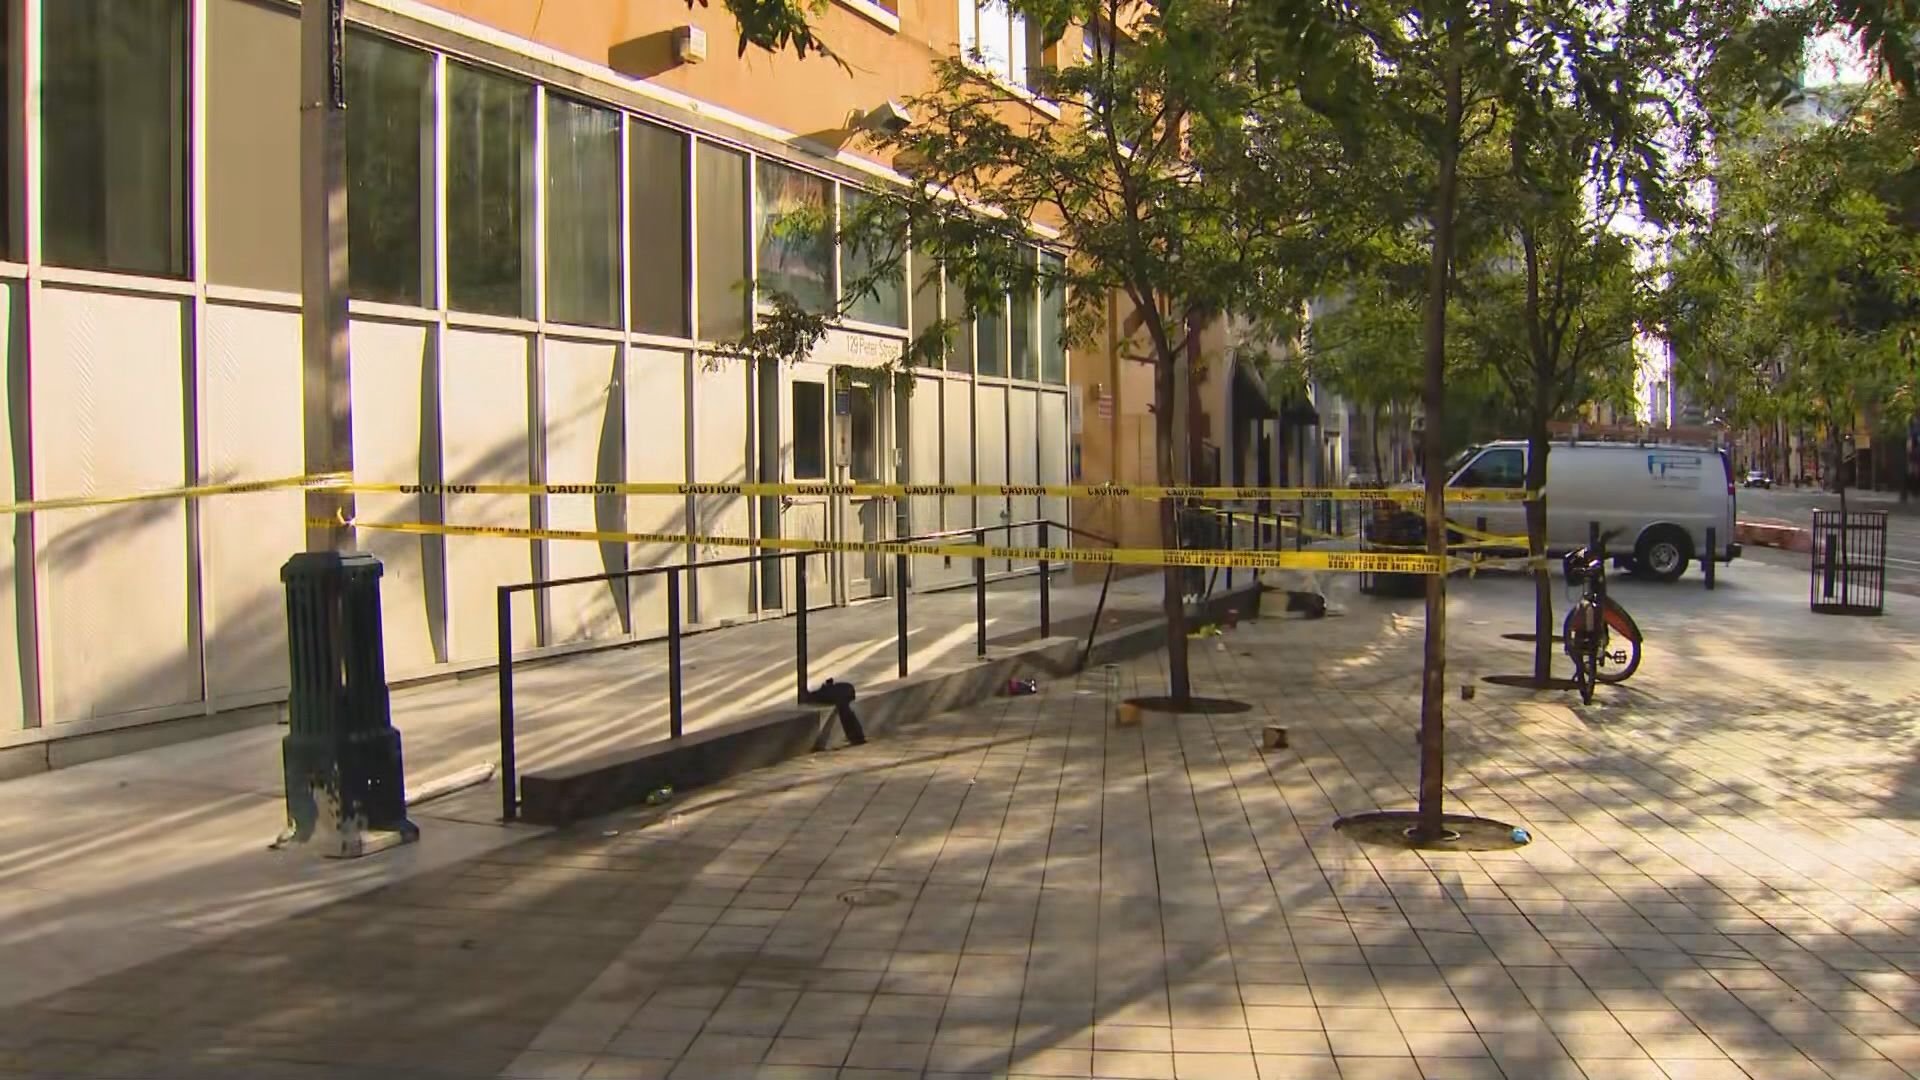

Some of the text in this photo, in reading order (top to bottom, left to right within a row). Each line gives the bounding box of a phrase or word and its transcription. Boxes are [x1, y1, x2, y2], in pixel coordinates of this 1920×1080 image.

[847, 335, 858, 354] 129
[860, 336, 877, 356] Peter
[400, 485, 477, 494] CAUTION
[546, 485, 616, 495] CAUTION
[678, 485, 741, 495] CAUTION
[797, 485, 854, 495] CAUTION
[904, 487, 955, 496] CAUTION
[1001, 487, 1046, 496] CAUTION
[1087, 486, 1129, 497] CAUTION
[1166, 488, 1204, 497] CAUTION
[814, 541, 844, 550] CROSS
[847, 543, 864, 551] NOT
[885, 545, 904, 553] LINE
[908, 545, 939, 554] POLICE
[991, 550, 1113, 561] POLICE LINE DO NOT CROSS
[1163, 555, 1191, 564] CROSS
[1195, 556, 1210, 565] NOT
[1214, 557, 1226, 566] DO
[1252, 558, 1280, 567] POLICE
[1328, 561, 1440, 572] POLICE LINE DO NOT CROSS
